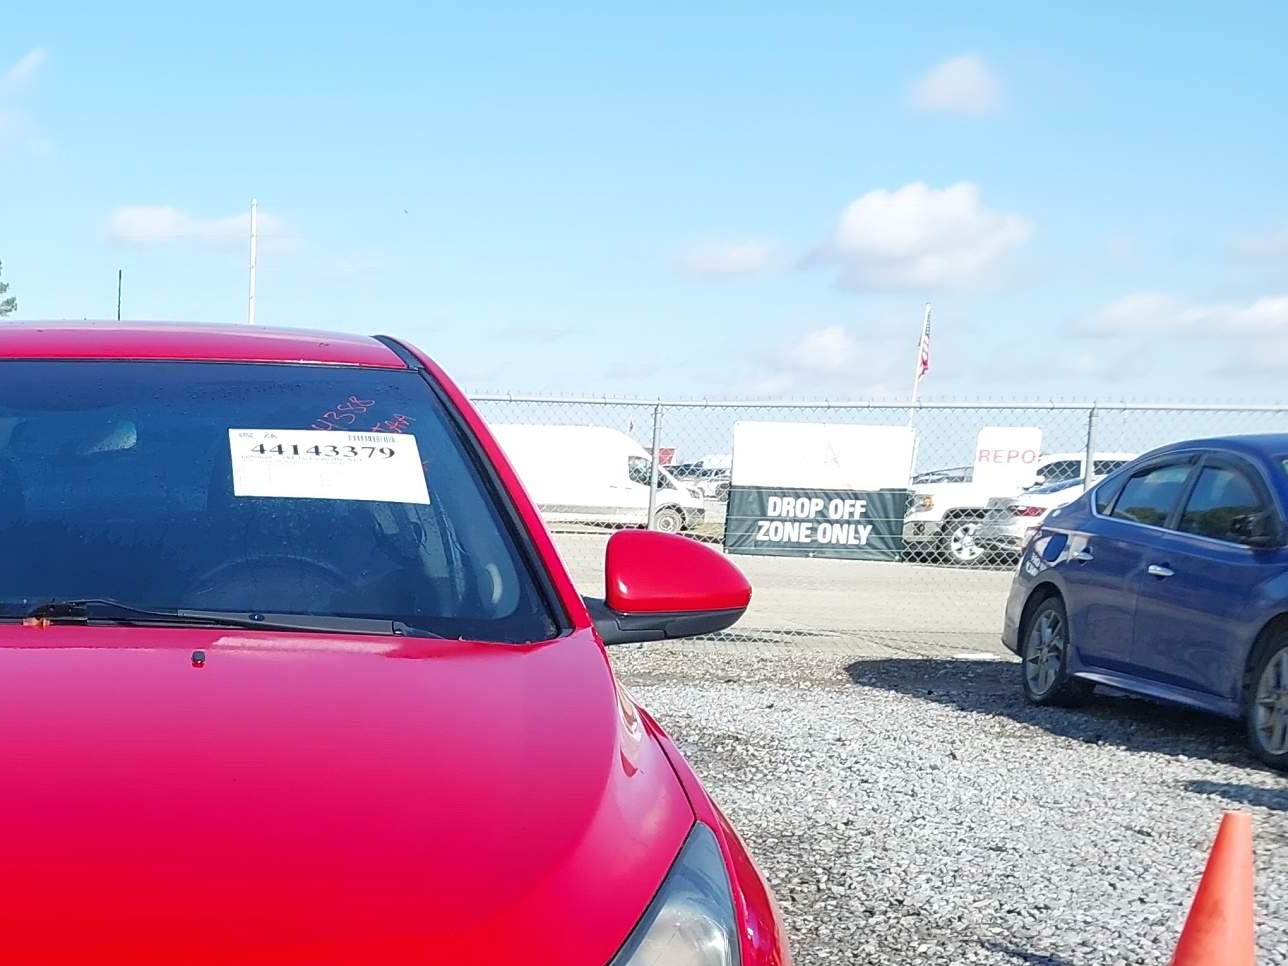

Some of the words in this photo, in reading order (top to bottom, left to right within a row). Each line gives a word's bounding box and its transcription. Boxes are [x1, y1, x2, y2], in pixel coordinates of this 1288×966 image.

[250, 443, 396, 459] 44143379
[978, 449, 1037, 464] REPO
[767, 497, 824, 519] DROP
[829, 499, 867, 521] OFF
[756, 520, 813, 542] ZONE
[817, 523, 873, 545] ONLY
